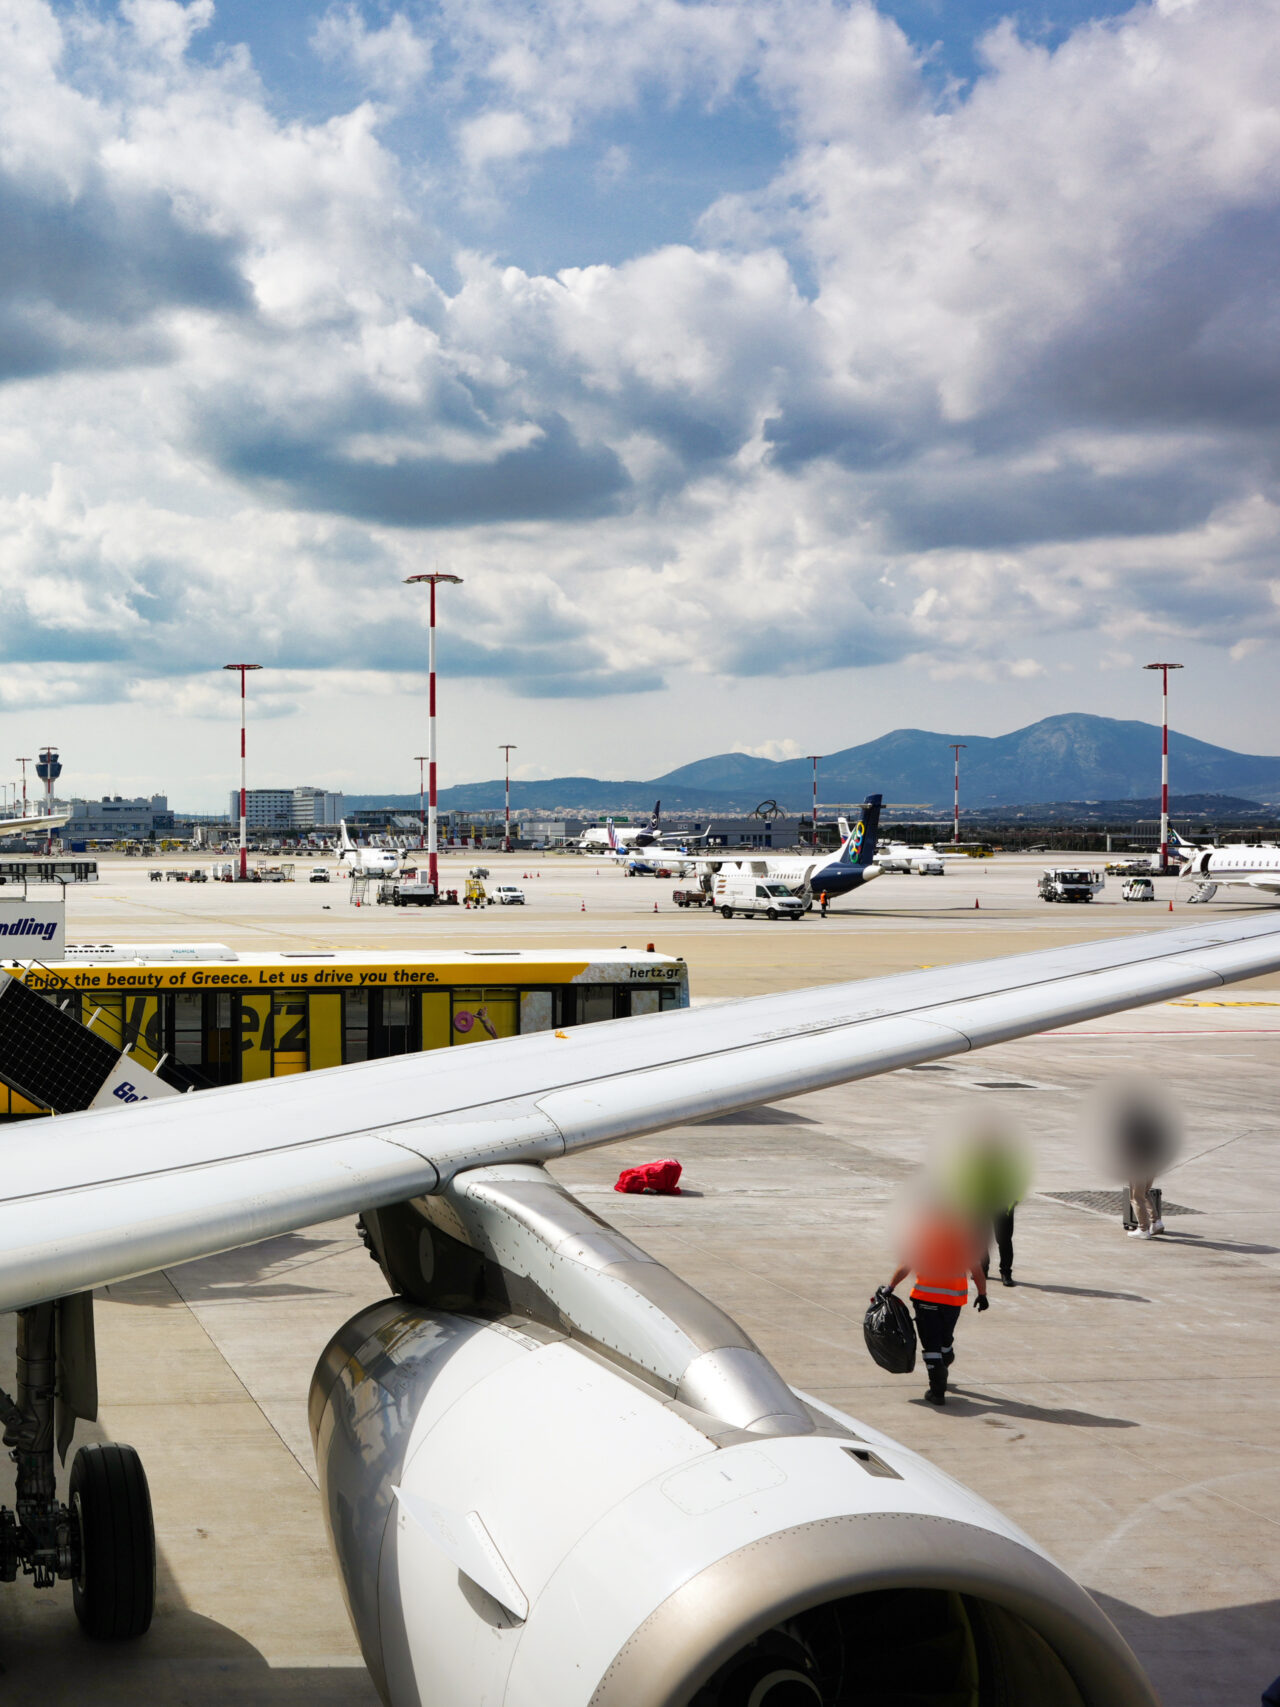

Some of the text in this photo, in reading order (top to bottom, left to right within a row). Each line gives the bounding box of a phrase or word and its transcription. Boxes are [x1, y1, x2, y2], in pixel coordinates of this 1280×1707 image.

[24, 969, 440, 990] Enjoy the beauty of Greece. Let us drive you there.
[629, 967, 680, 979] hertz.gr
